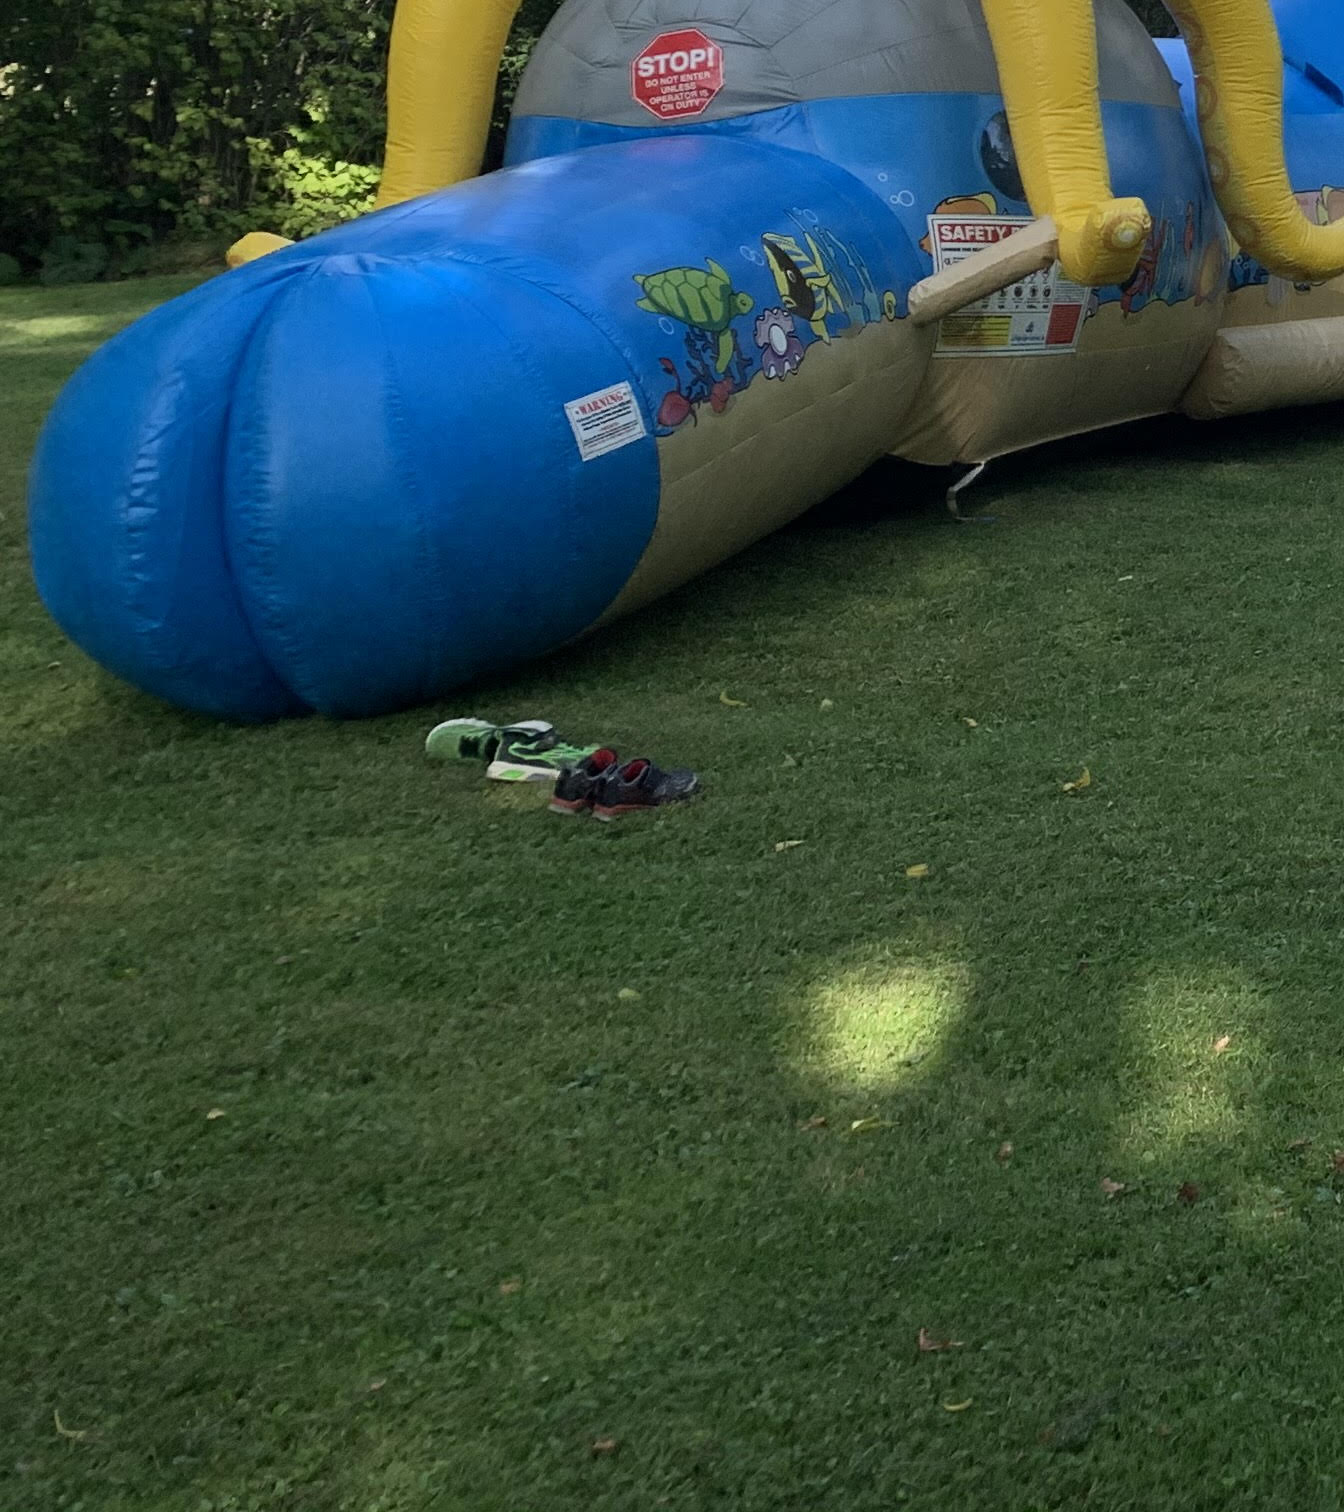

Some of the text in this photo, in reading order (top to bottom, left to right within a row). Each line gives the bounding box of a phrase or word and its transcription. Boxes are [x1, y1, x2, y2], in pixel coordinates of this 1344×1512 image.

[638, 47, 714, 77] STOP!
[645, 71, 711, 88] DO NOT ENTER
[661, 82, 697, 94] UNLESS
[649, 90, 698, 105] OPERATOR
[675, 99, 701, 110] DUTY
[940, 225, 1007, 241] SAFETY
[578, 391, 624, 415] WARNING
